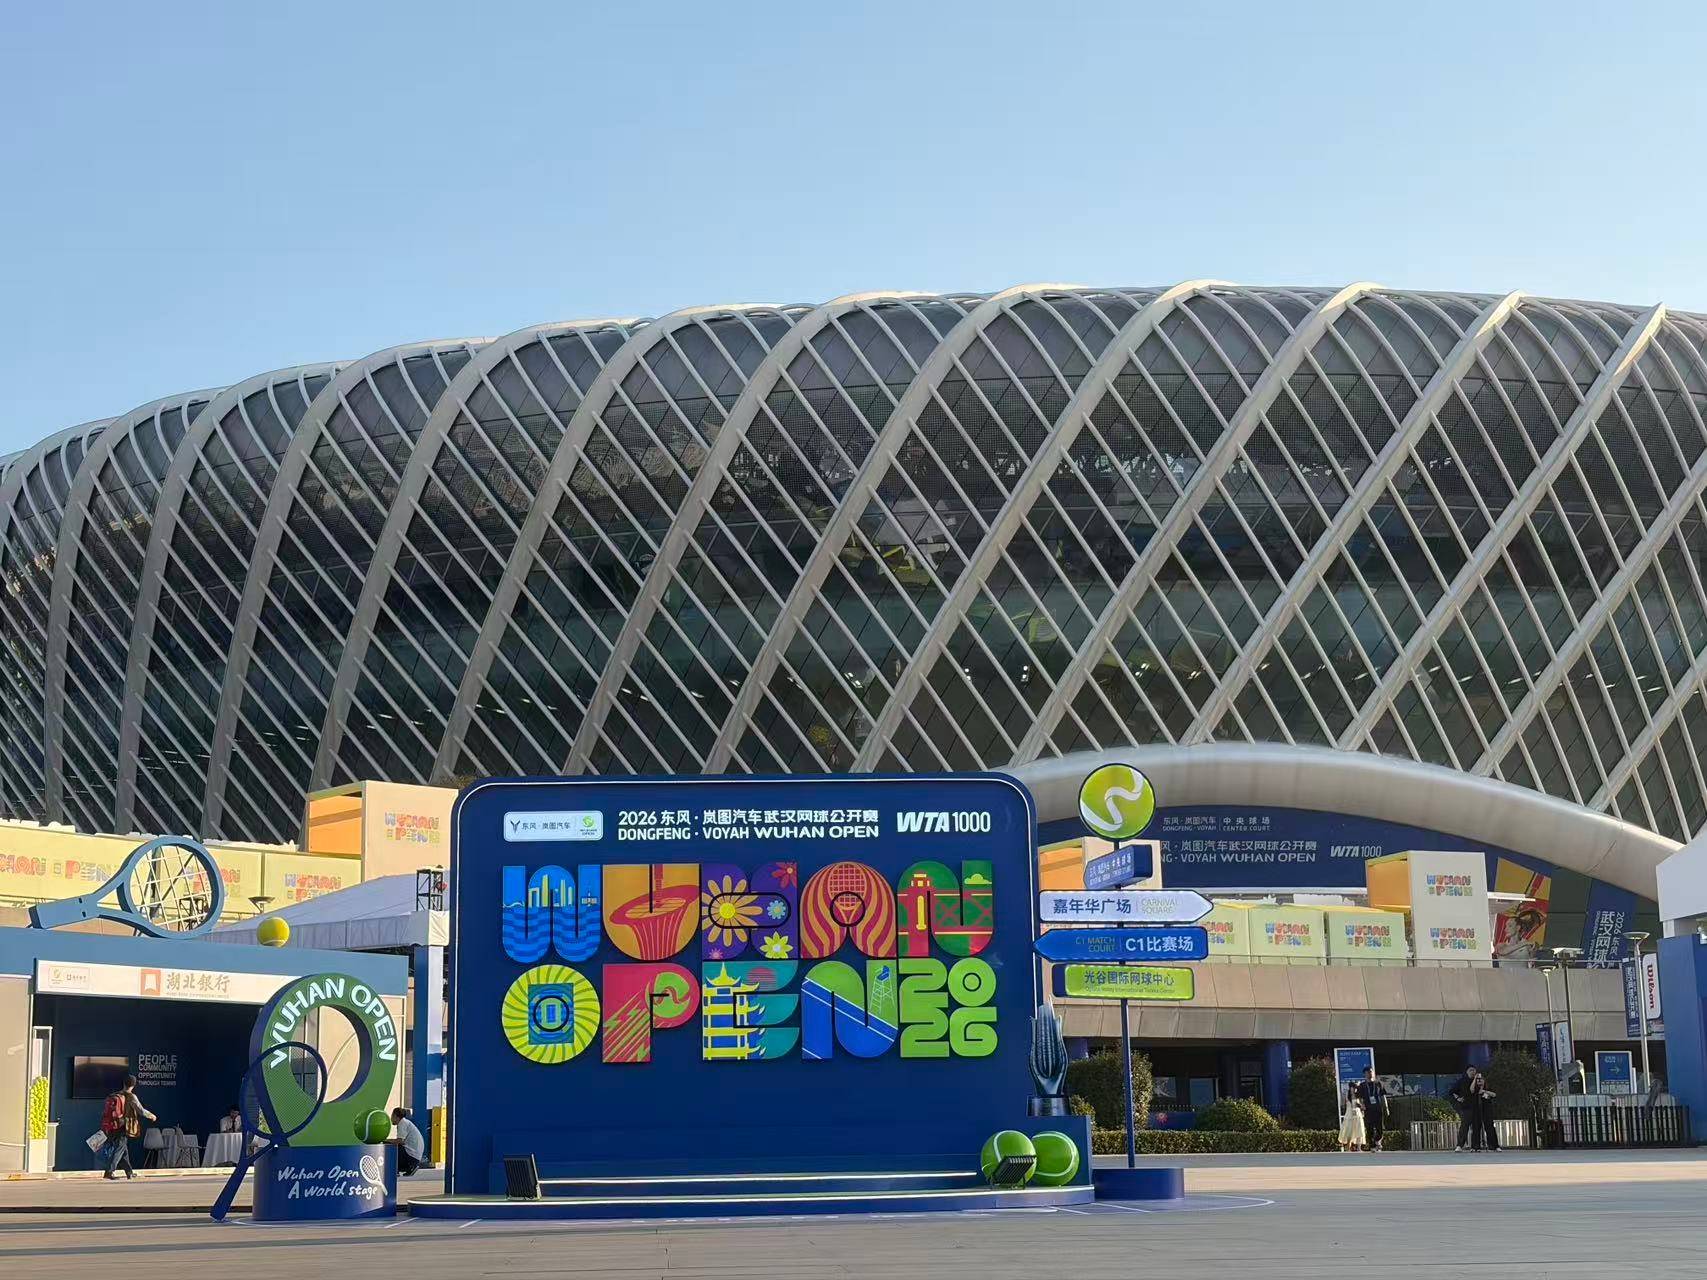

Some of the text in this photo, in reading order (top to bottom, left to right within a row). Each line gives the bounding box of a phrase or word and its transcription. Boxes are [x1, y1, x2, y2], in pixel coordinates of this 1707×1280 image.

[618, 811, 657, 825] 2026
[896, 811, 991, 833] WTA 1000
[703, 827, 749, 839] VOYAH
[754, 826, 825, 839] WUHAN
[829, 825, 879, 838] OPEN
[1221, 853, 1274, 863] WUHAN
[1277, 853, 1316, 862] OPEN
[1330, 845, 1382, 857] WTA 1000
[502, 860, 995, 963] WUHAN
[1053, 898, 1131, 914] 嘉年华广场
[1125, 936, 1194, 952] C1比赛场
[1084, 970, 1175, 986] 光谷国际网球中心
[1647, 964, 1656, 1010] Wilson
[502, 958, 899, 1063] OPEN
[270, 978, 397, 1069] WUHAN OPEN
[138, 1054, 177, 1064] PEOPLE
[278, 1165, 359, 1182] Wuhan Open
[287, 1181, 378, 1200] A world stage
